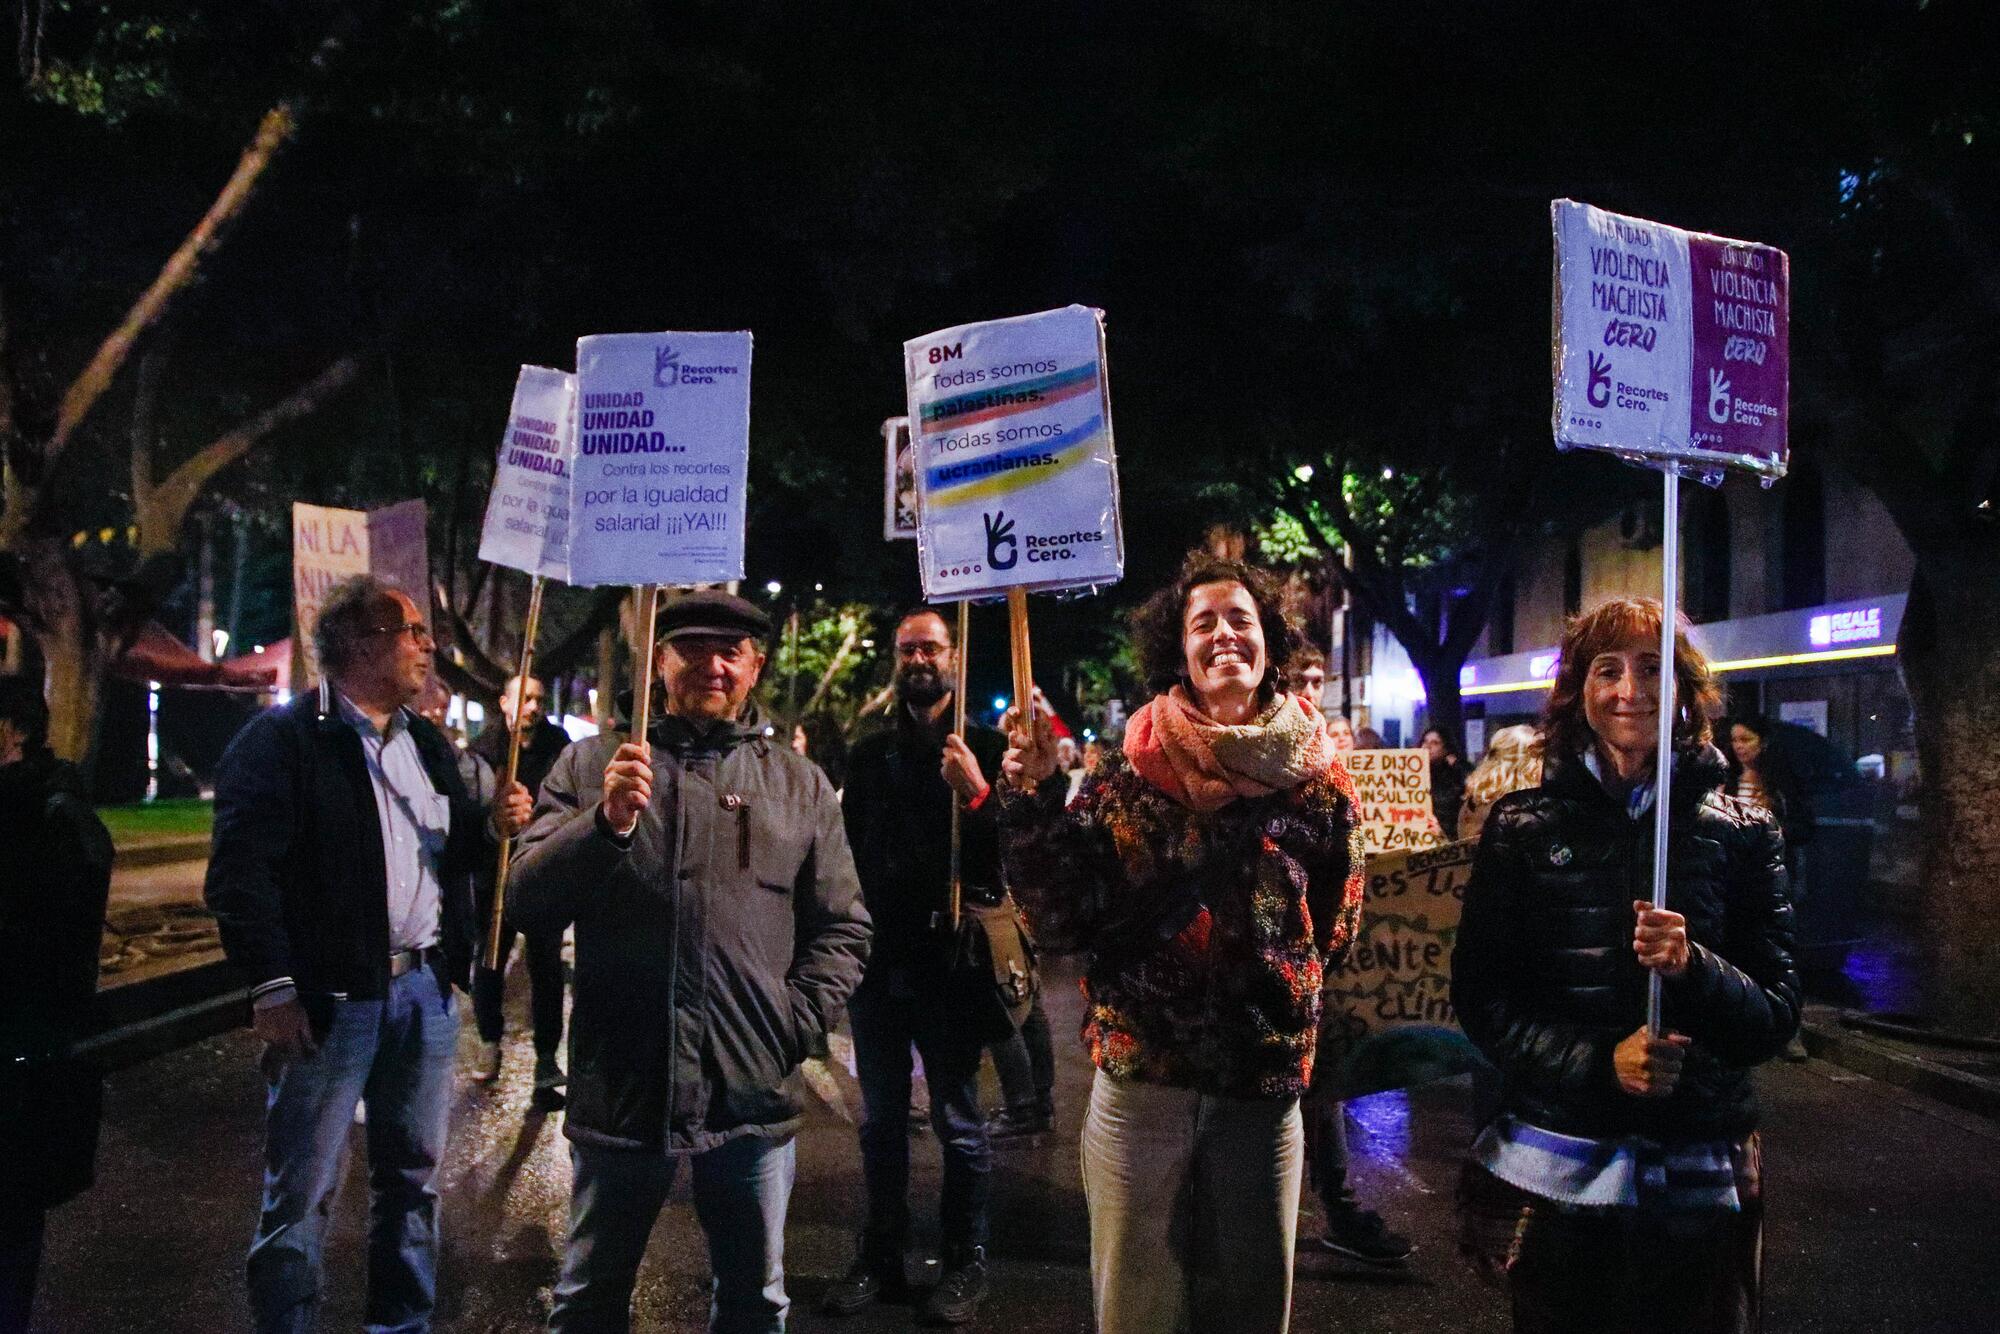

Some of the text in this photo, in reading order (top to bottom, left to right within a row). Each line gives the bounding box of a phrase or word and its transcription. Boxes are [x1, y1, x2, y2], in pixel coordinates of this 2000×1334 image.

[1590, 246, 1670, 288] VIOLENCIA
[1711, 268, 1778, 306] VIOLENCIA
[1592, 281, 1667, 322] MACHISTA
[1714, 300, 1776, 337] MACHISTA
[1603, 318, 1657, 352] CERO
[928, 342, 963, 365] 8M
[1724, 335, 1767, 366] CERO
[681, 364, 738, 375] Recortes
[681, 374, 717, 384] Cero.
[932, 359, 1058, 390] Todas somos
[585, 391, 644, 409] UNIDAD
[1616, 382, 1669, 402] Recortes
[932, 389, 1045, 421] palestinas.
[1616, 396, 1650, 412] Cero.
[1734, 397, 1778, 417] Recortes
[516, 415, 556, 435] UNIDAD
[583, 410, 655, 430] UNIDAD
[1733, 412, 1763, 427] Cero.
[512, 430, 560, 454] UNIDAD
[582, 431, 686, 455] UNIDAD...
[936, 423, 1063, 453] Todas somos
[602, 462, 731, 477] Contra los recortes
[938, 452, 1059, 481] ucranianas.
[584, 489, 617, 508] por
[622, 486, 638, 503] la
[644, 485, 728, 507] igualdad
[594, 512, 726, 535] salarial ¡¡¡YA!!!
[326, 519, 360, 555] LA
[1026, 531, 1103, 548] Recortes
[1027, 548, 1077, 562] Cero.
[1831, 608, 1880, 631] REALE
[1381, 754, 1423, 773] DIJO
[1362, 806, 1384, 821] LA
